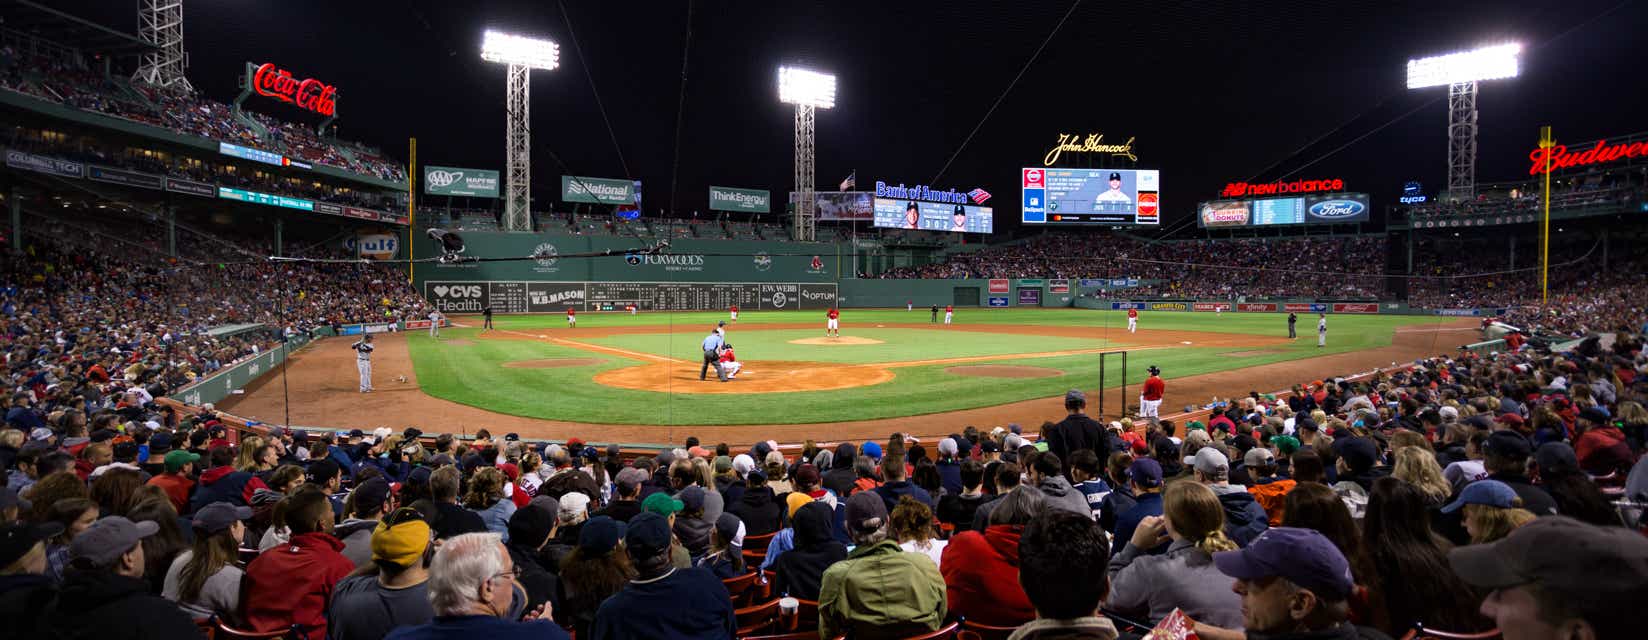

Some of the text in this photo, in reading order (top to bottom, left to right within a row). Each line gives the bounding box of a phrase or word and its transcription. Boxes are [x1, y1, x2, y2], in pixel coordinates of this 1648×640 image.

[254, 63, 335, 116] Coca-Cola
[1044, 133, 1138, 166] John Hancock
[428, 170, 453, 186] AAA
[581, 181, 629, 195] National
[875, 181, 968, 204] Bank of America
[1400, 196, 1426, 205] tyco
[1319, 202, 1353, 216] Ford
[644, 253, 704, 266] FOXWOODS
[449, 285, 482, 298] CVS
[776, 285, 797, 293] WEBB
[809, 292, 835, 300] OPTUM
[436, 299, 482, 312] Health
[1246, 303, 1268, 311] xfinity
